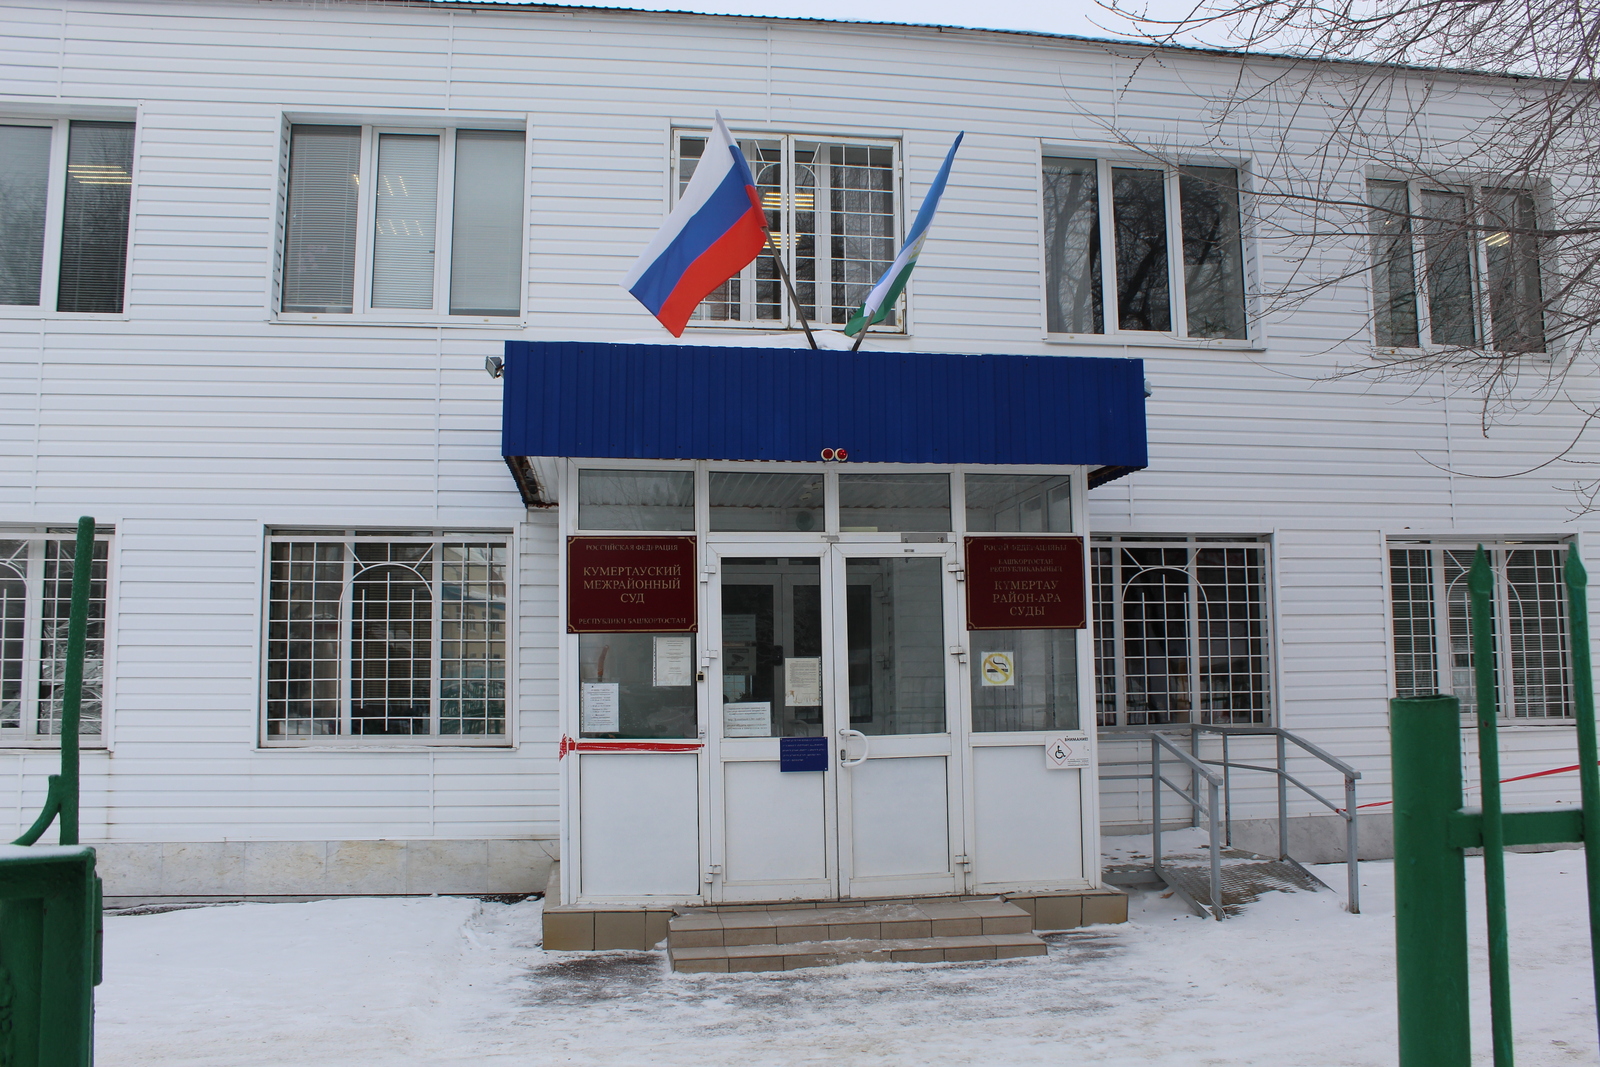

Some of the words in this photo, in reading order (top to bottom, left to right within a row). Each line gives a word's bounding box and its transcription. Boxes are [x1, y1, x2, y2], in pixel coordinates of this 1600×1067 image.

[583, 564, 681, 576] КУМЕРТАУСКИЙ
[583, 577, 680, 589] МЕЖРАЙОННЫЙ
[620, 593, 645, 604] СУД
[992, 591, 1061, 603] РАЙОН-АРА
[1009, 606, 1045, 617] СУДЫ
